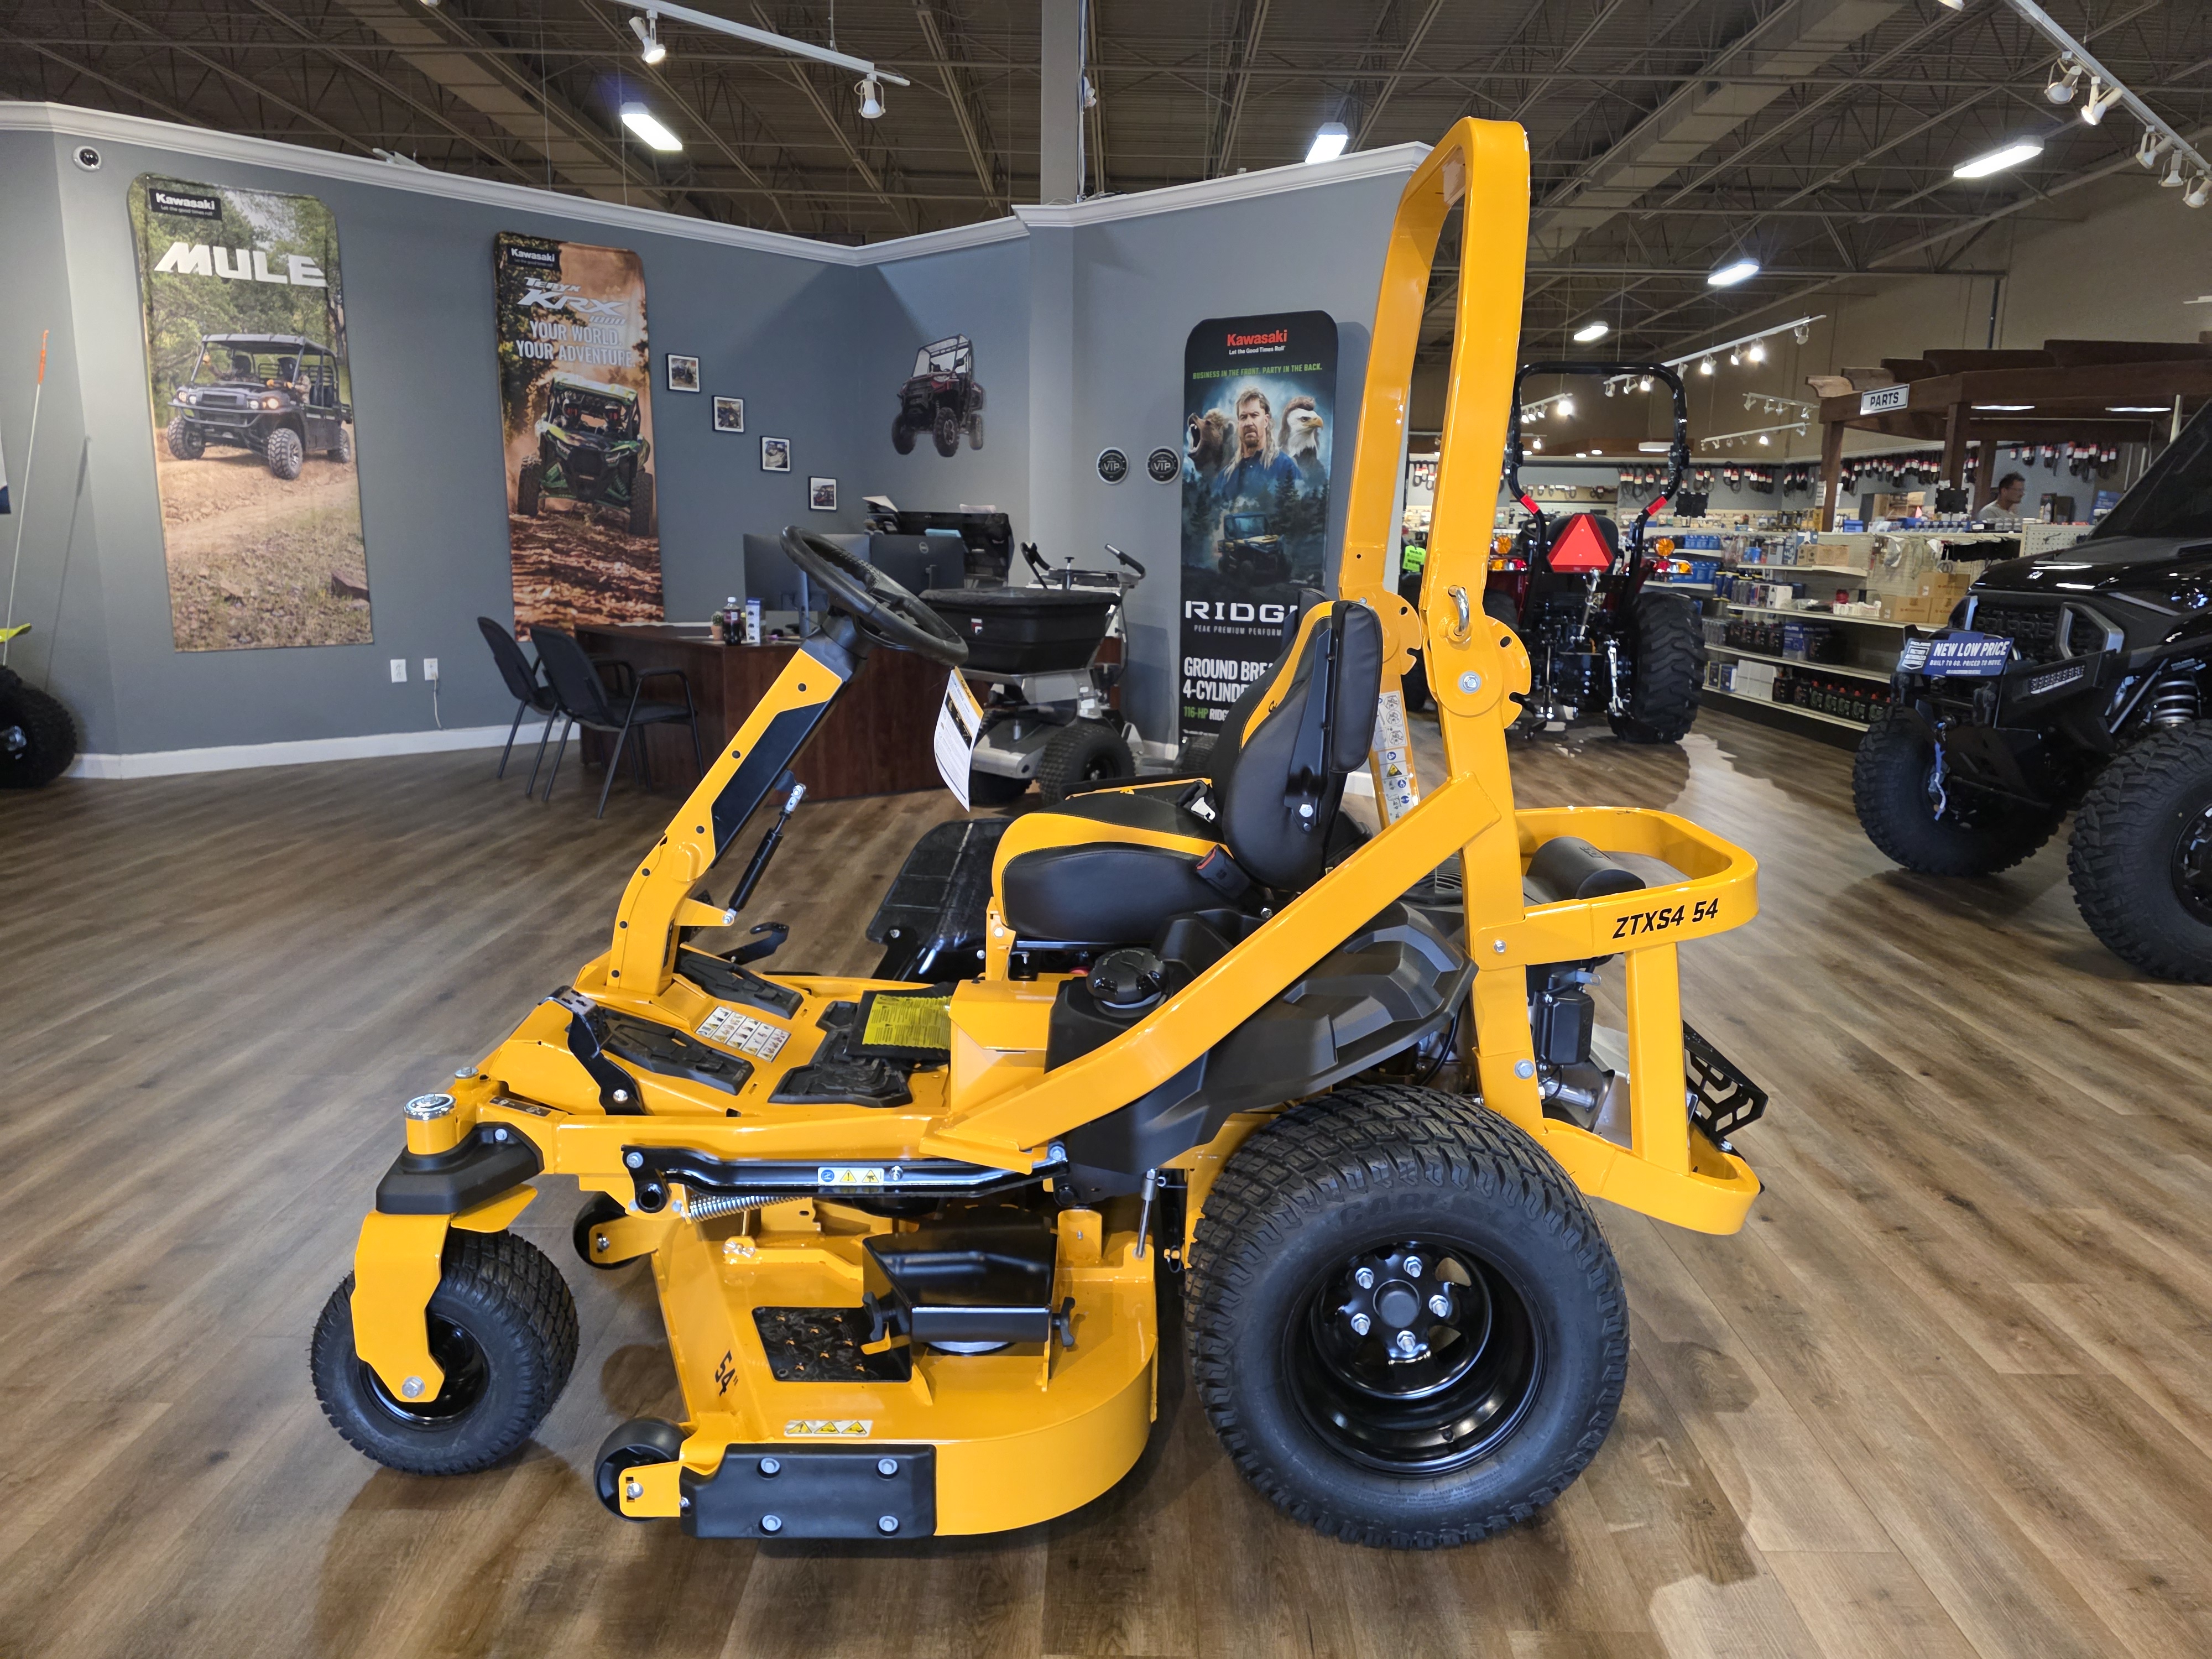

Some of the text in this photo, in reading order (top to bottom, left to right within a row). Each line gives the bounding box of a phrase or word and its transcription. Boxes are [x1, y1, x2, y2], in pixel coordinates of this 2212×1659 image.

[155, 192, 215, 210] Kawasaki
[511, 248, 555, 262] Kawasaki
[154, 242, 327, 288] MULE
[517, 288, 625, 316] KRX
[589, 316, 626, 325] 1000
[530, 321, 623, 346] YOUR WORLD.
[1227, 330, 1287, 346] Kawasaki
[516, 340, 636, 368] YOUR ADVENTURE.
[1193, 371, 1220, 379] BUSINESS
[1240, 367, 1261, 375] FRONT.
[1304, 363, 1322, 371] BACK.
[1870, 392, 1899, 408] PARTS
[1104, 463, 1120, 471] VIP
[1154, 462, 1171, 471] VIP
[1185, 601, 1298, 623] RIDG
[1213, 625, 1245, 634] PREMIUM
[1933, 643, 1958, 657] NEW
[1957, 643, 1981, 657] LOW
[1980, 641, 2010, 656] PRICE
[1184, 656, 1274, 681] GROUND BRE
[1183, 679, 1250, 703] 4-CYLIND
[1184, 706, 1208, 718] 116-HP
[1612, 898, 1719, 939] ZTXS4 54
